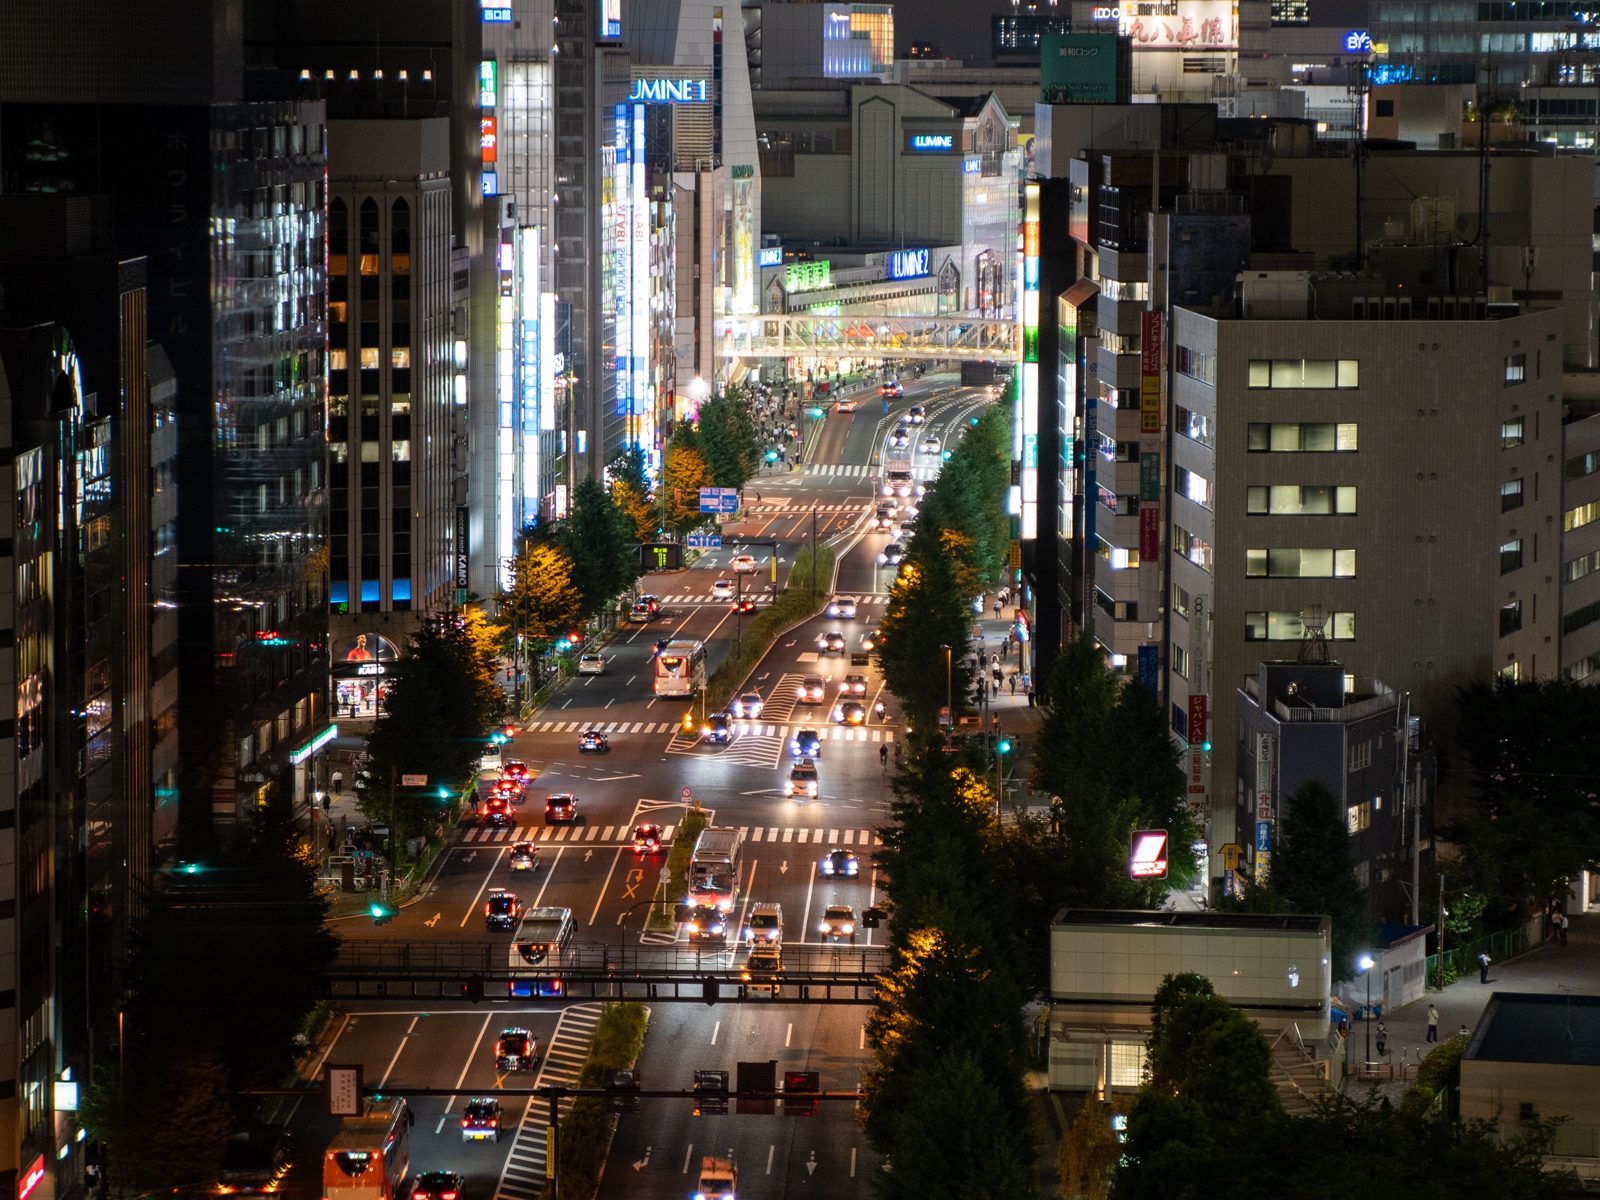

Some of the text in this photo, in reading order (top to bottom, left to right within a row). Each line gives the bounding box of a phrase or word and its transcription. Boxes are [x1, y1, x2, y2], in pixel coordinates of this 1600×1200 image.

[698, 78, 707, 101] 1
[914, 135, 953, 147] LUMINE
[895, 248, 930, 278] LUMINE 2
[458, 554, 467, 586] KAMO
[1192, 696, 1203, 744] ジャパンAG
